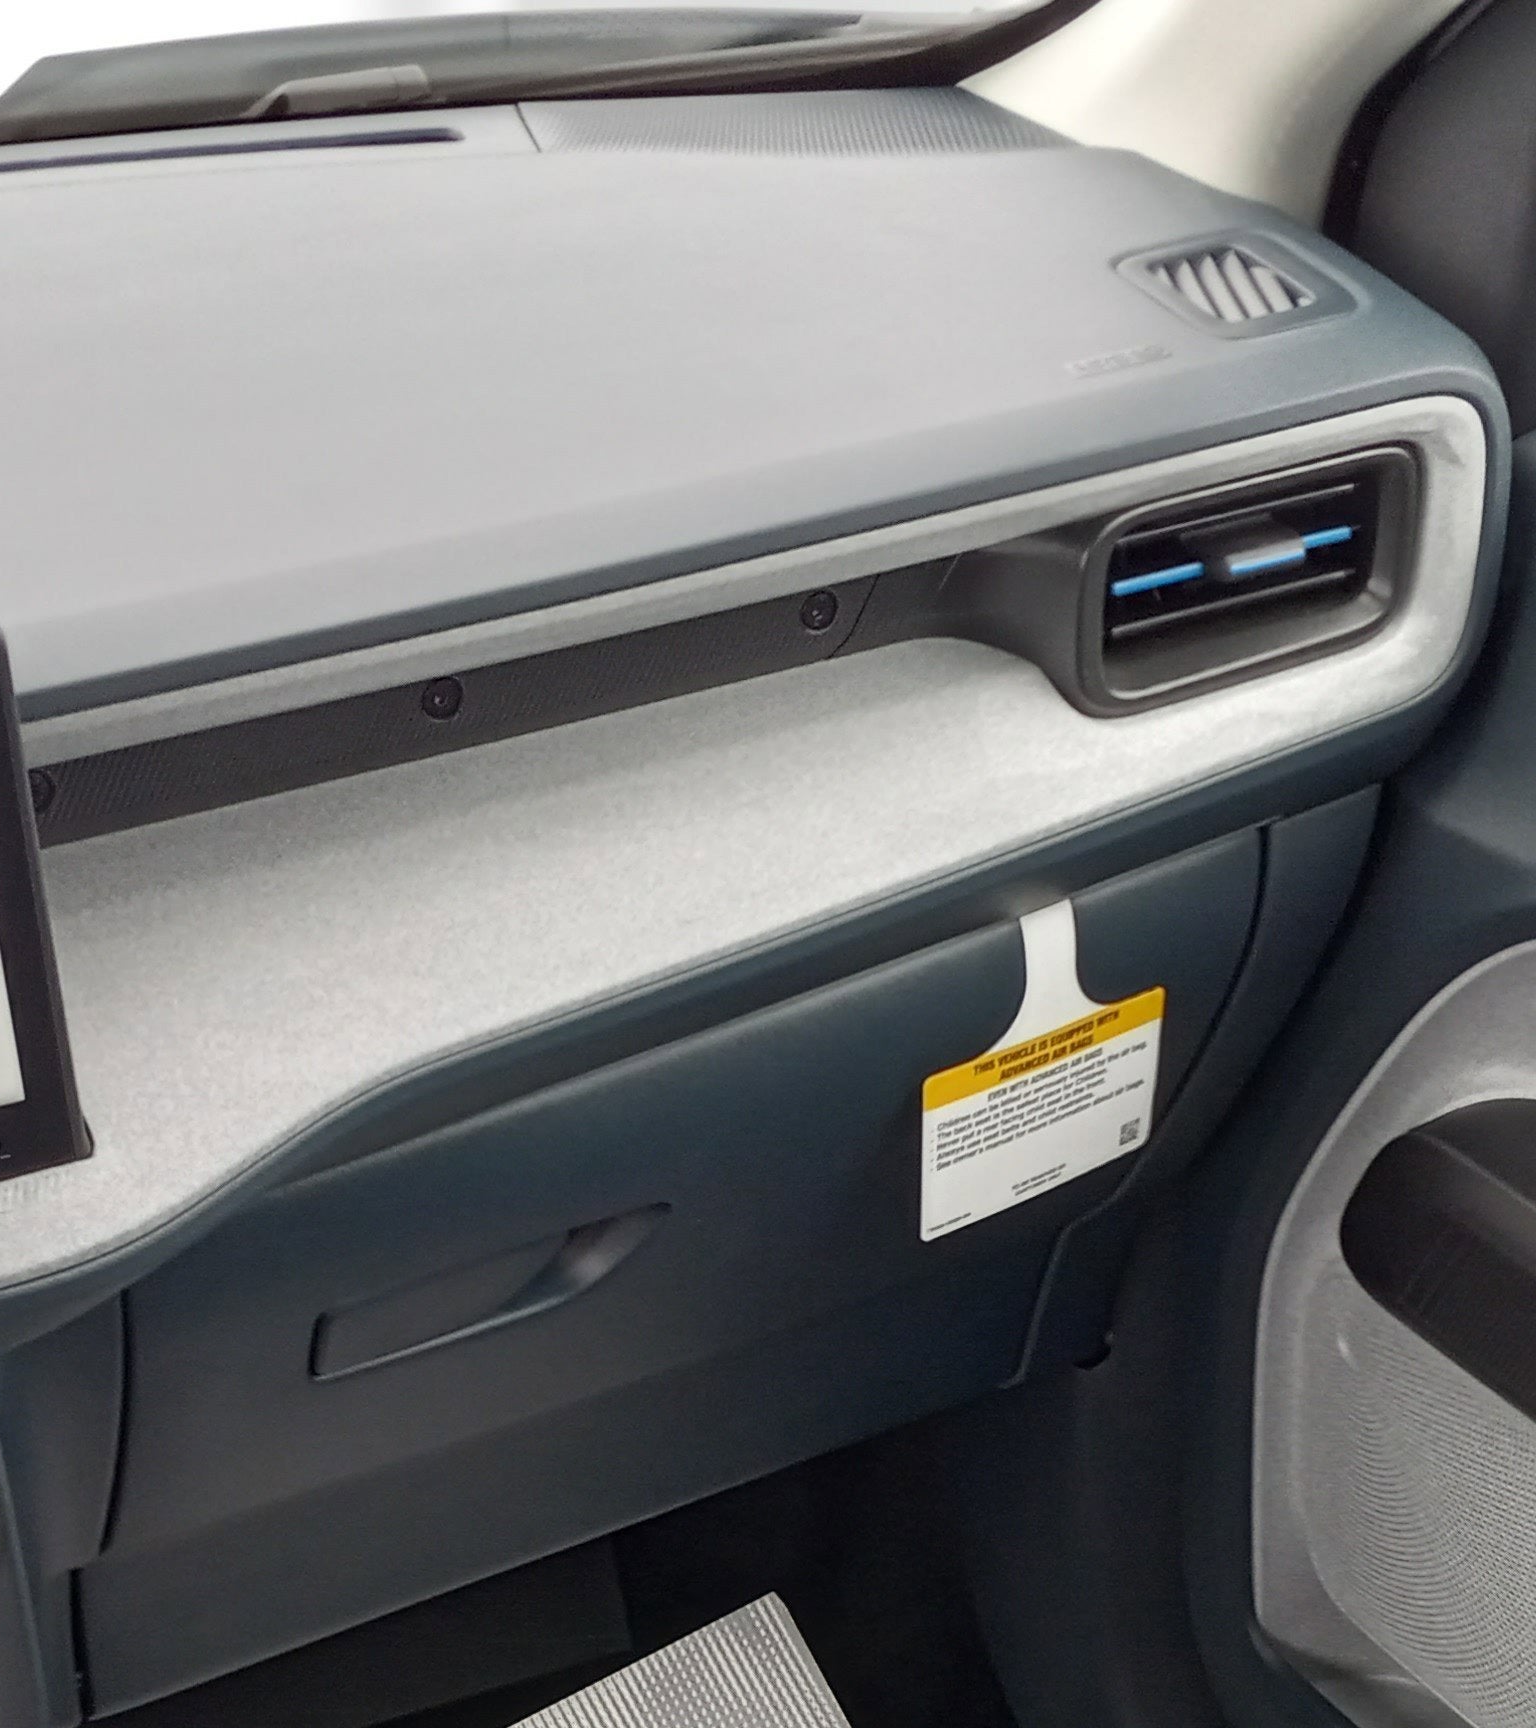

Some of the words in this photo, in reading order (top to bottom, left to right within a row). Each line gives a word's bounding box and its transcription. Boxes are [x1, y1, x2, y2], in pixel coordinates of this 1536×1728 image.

[998, 1043, 1036, 1067] VEHICLE
[999, 1053, 1050, 1081] ADVANCED
[1052, 1046, 1067, 1060] AIR
